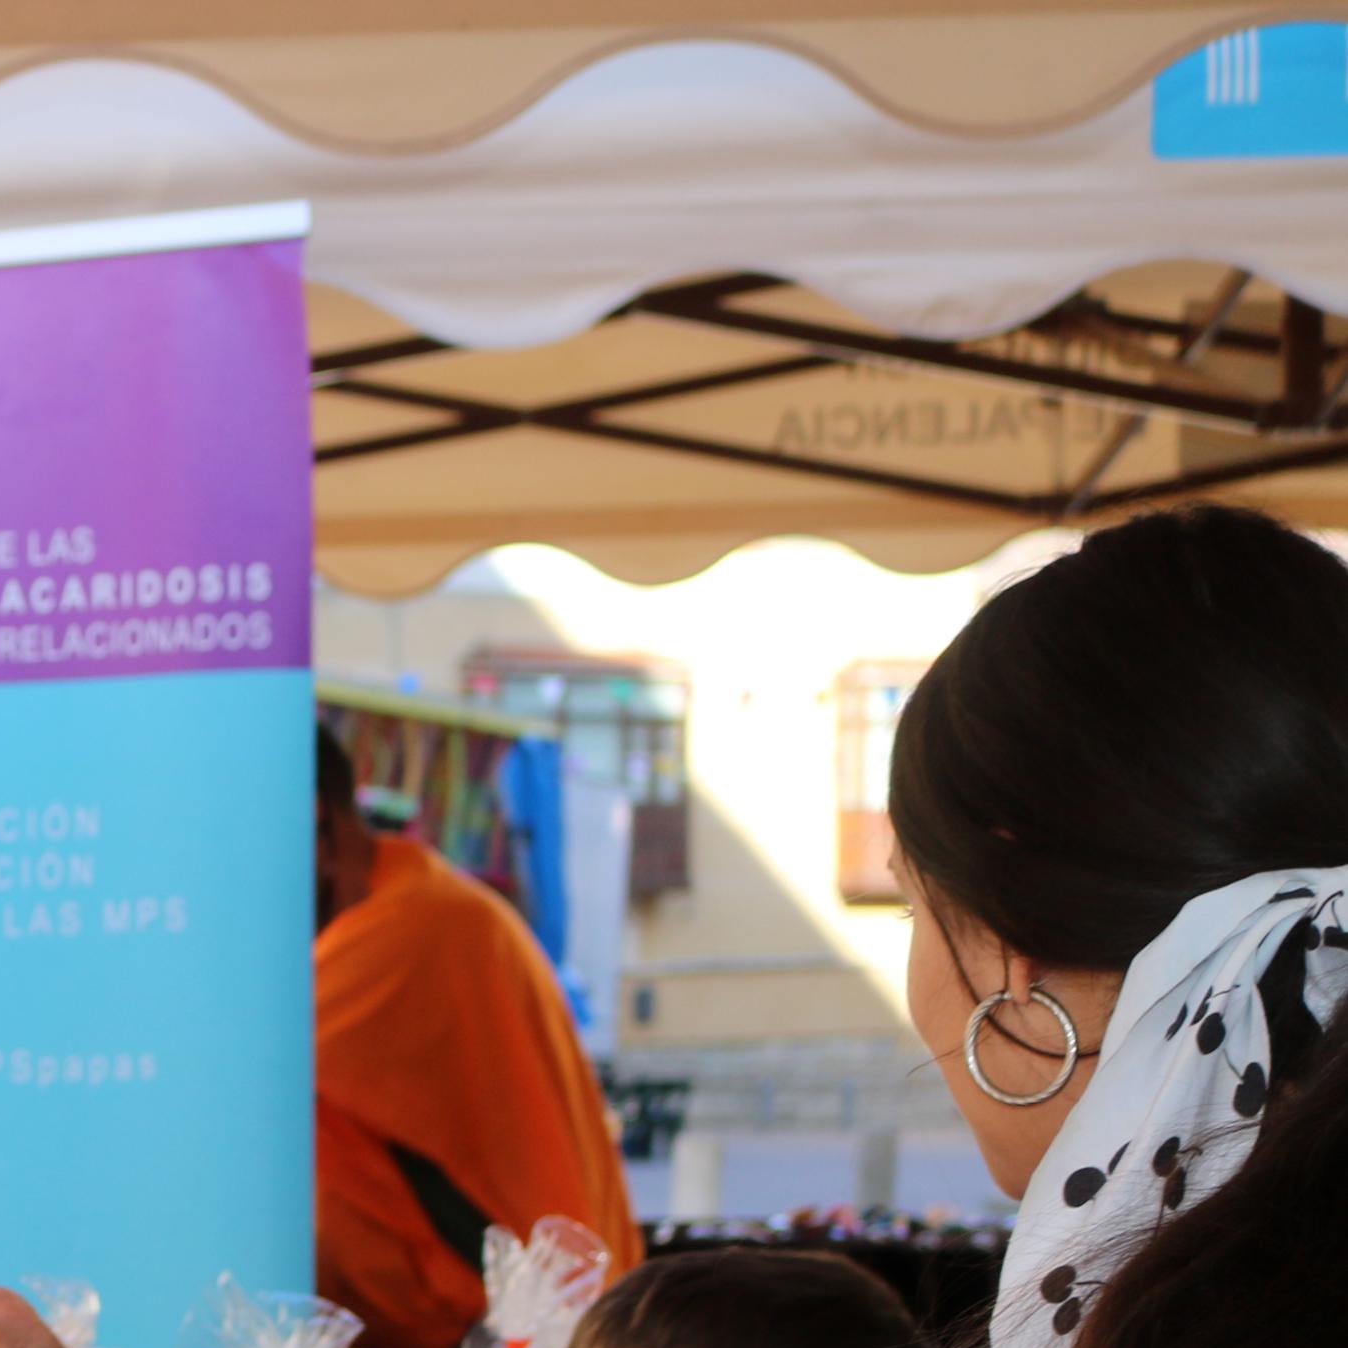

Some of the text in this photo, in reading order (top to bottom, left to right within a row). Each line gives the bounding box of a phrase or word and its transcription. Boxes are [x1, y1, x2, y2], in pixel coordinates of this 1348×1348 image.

[28, 525, 96, 567] LAS
[3, 899, 83, 940] LAS
[102, 896, 187, 935] MPS
